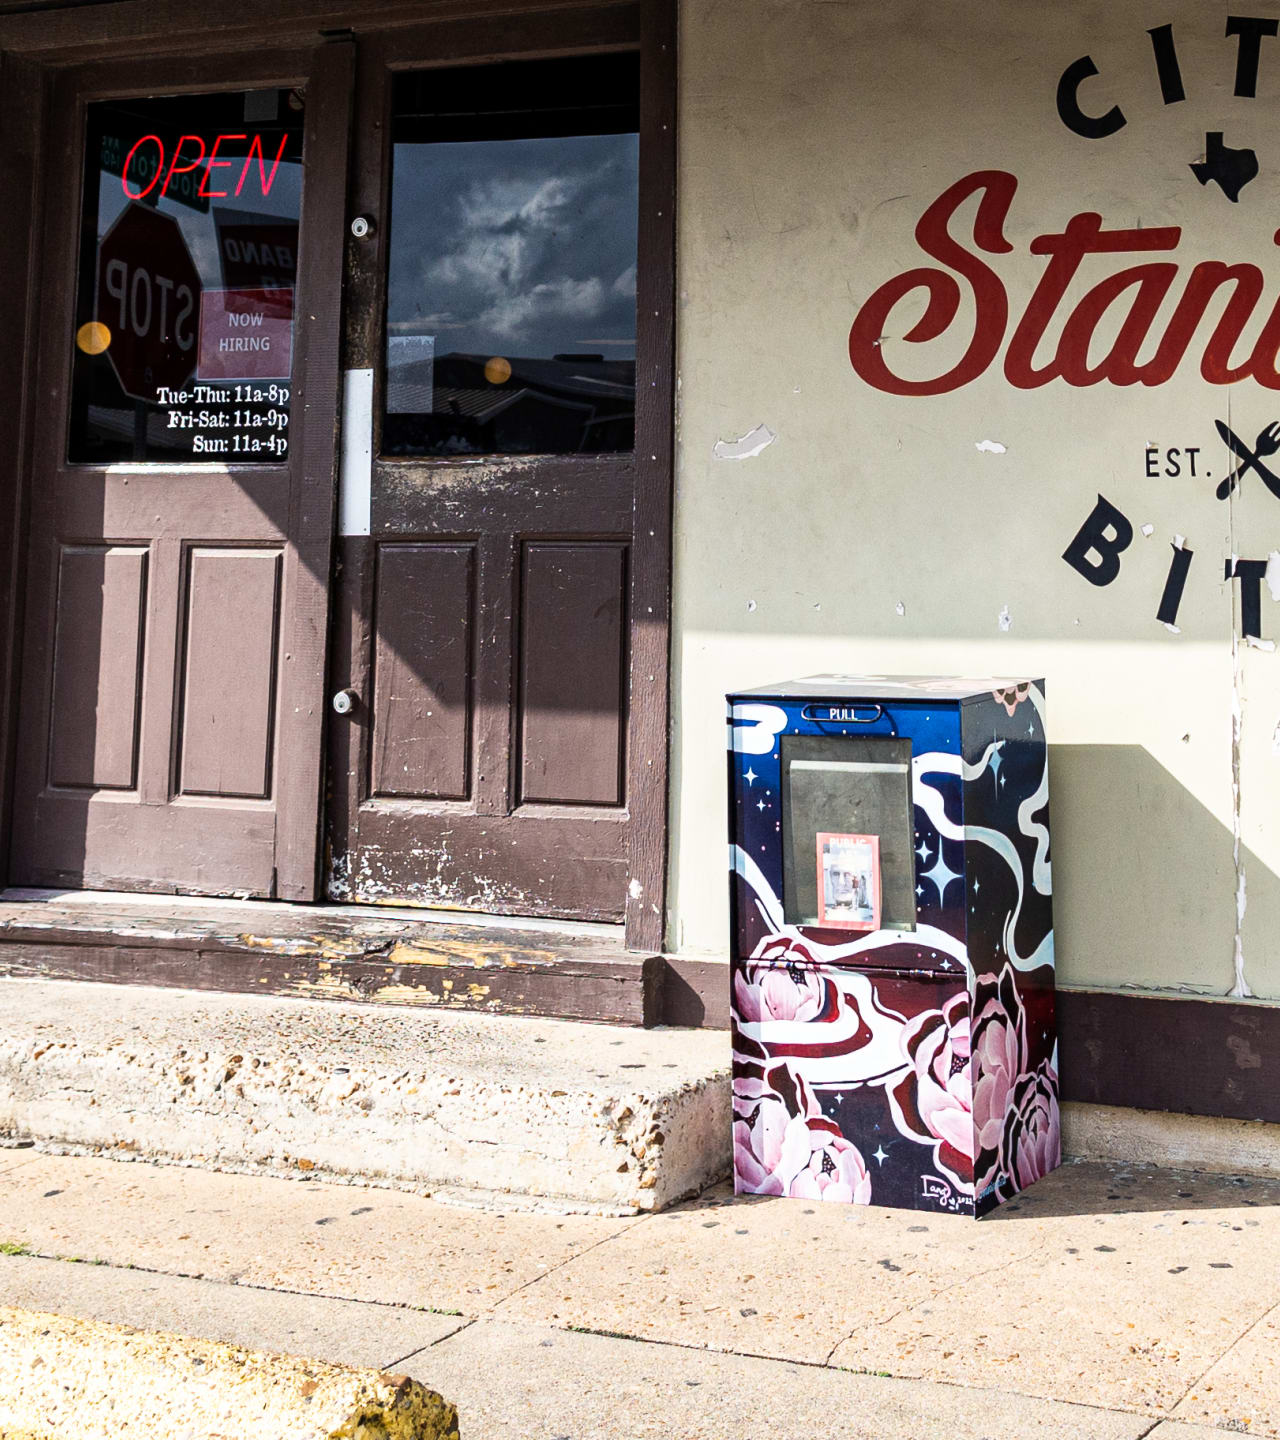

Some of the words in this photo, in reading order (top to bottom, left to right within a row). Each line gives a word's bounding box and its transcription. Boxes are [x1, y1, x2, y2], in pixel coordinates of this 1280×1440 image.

[121, 133, 288, 200] OPEN
[228, 312, 264, 327] NOW
[219, 336, 270, 352] HIRING
[156, 386, 231, 405] Tue-Thu:
[234, 384, 290, 406] 11a-8p
[166, 410, 230, 428] Fri-Sat:
[233, 409, 289, 430] 11a-9p
[192, 435, 229, 453] Sun:
[232, 434, 288, 455] 11a-4p
[1144, 447, 1212, 478] EST.
[829, 707, 858, 720] PULL
